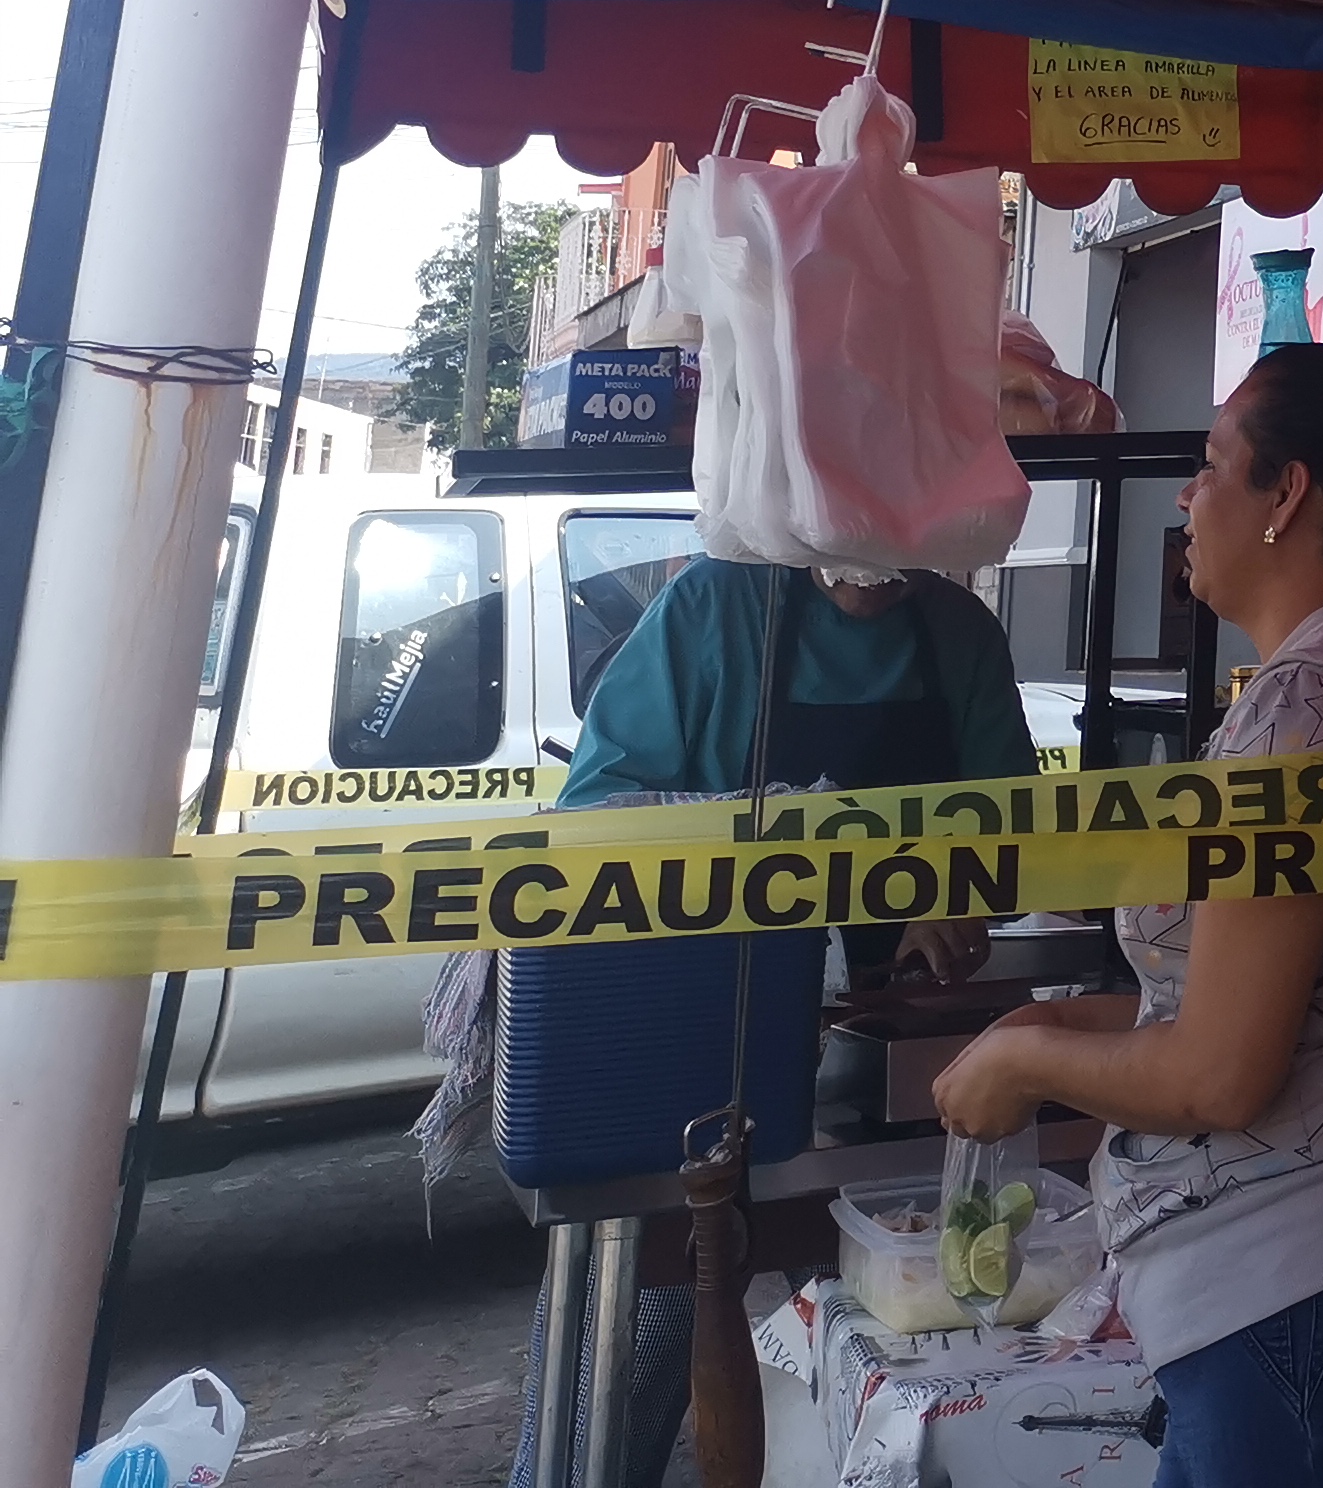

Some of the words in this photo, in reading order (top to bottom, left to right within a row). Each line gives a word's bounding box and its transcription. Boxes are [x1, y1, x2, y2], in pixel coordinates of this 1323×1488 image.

[1032, 58, 1056, 75] LA
[1067, 58, 1126, 72] LINEA
[1145, 60, 1215, 77] AMARILLA
[1032, 86, 1043, 102] Y
[1054, 85, 1074, 99] EL
[1084, 85, 1133, 98] AREA
[1150, 86, 1172, 100] DE
[1079, 112, 1181, 139] GRACIAS
[575, 363, 624, 377] META
[627, 363, 673, 378] PACK
[604, 381, 642, 389] MODELO
[583, 393, 656, 421] 400
[571, 430, 609, 445] Papel
[612, 431, 667, 443] Aluminio
[227, 844, 1018, 950] PRECAUCIÓN
[919, 1393, 988, 1425] roma
